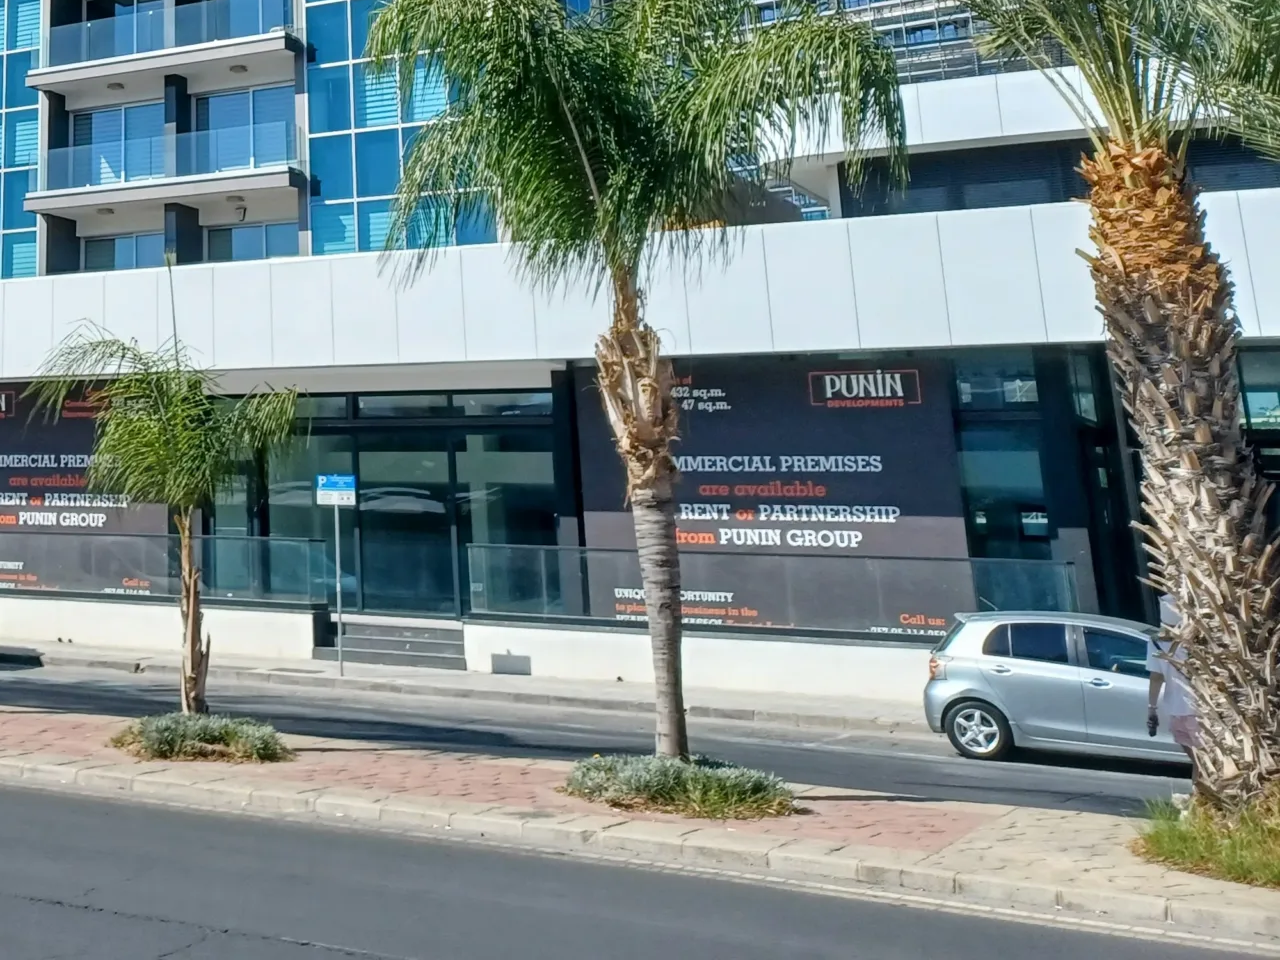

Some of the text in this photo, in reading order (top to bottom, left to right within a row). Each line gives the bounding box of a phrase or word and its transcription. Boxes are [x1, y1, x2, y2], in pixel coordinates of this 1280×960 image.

[827, 399, 904, 407] DEVELOPMENTS
[672, 456, 883, 472] MMERCIAL PREMISES
[8, 478, 27, 487] are
[699, 481, 826, 497] are available
[19, 512, 57, 526] PUNIN
[59, 512, 107, 527] GROUP
[680, 504, 731, 520] RENT
[759, 505, 900, 523] PARTNERSHIP
[676, 528, 863, 548] from PUNIN GROUP
[900, 613, 925, 625] Call
